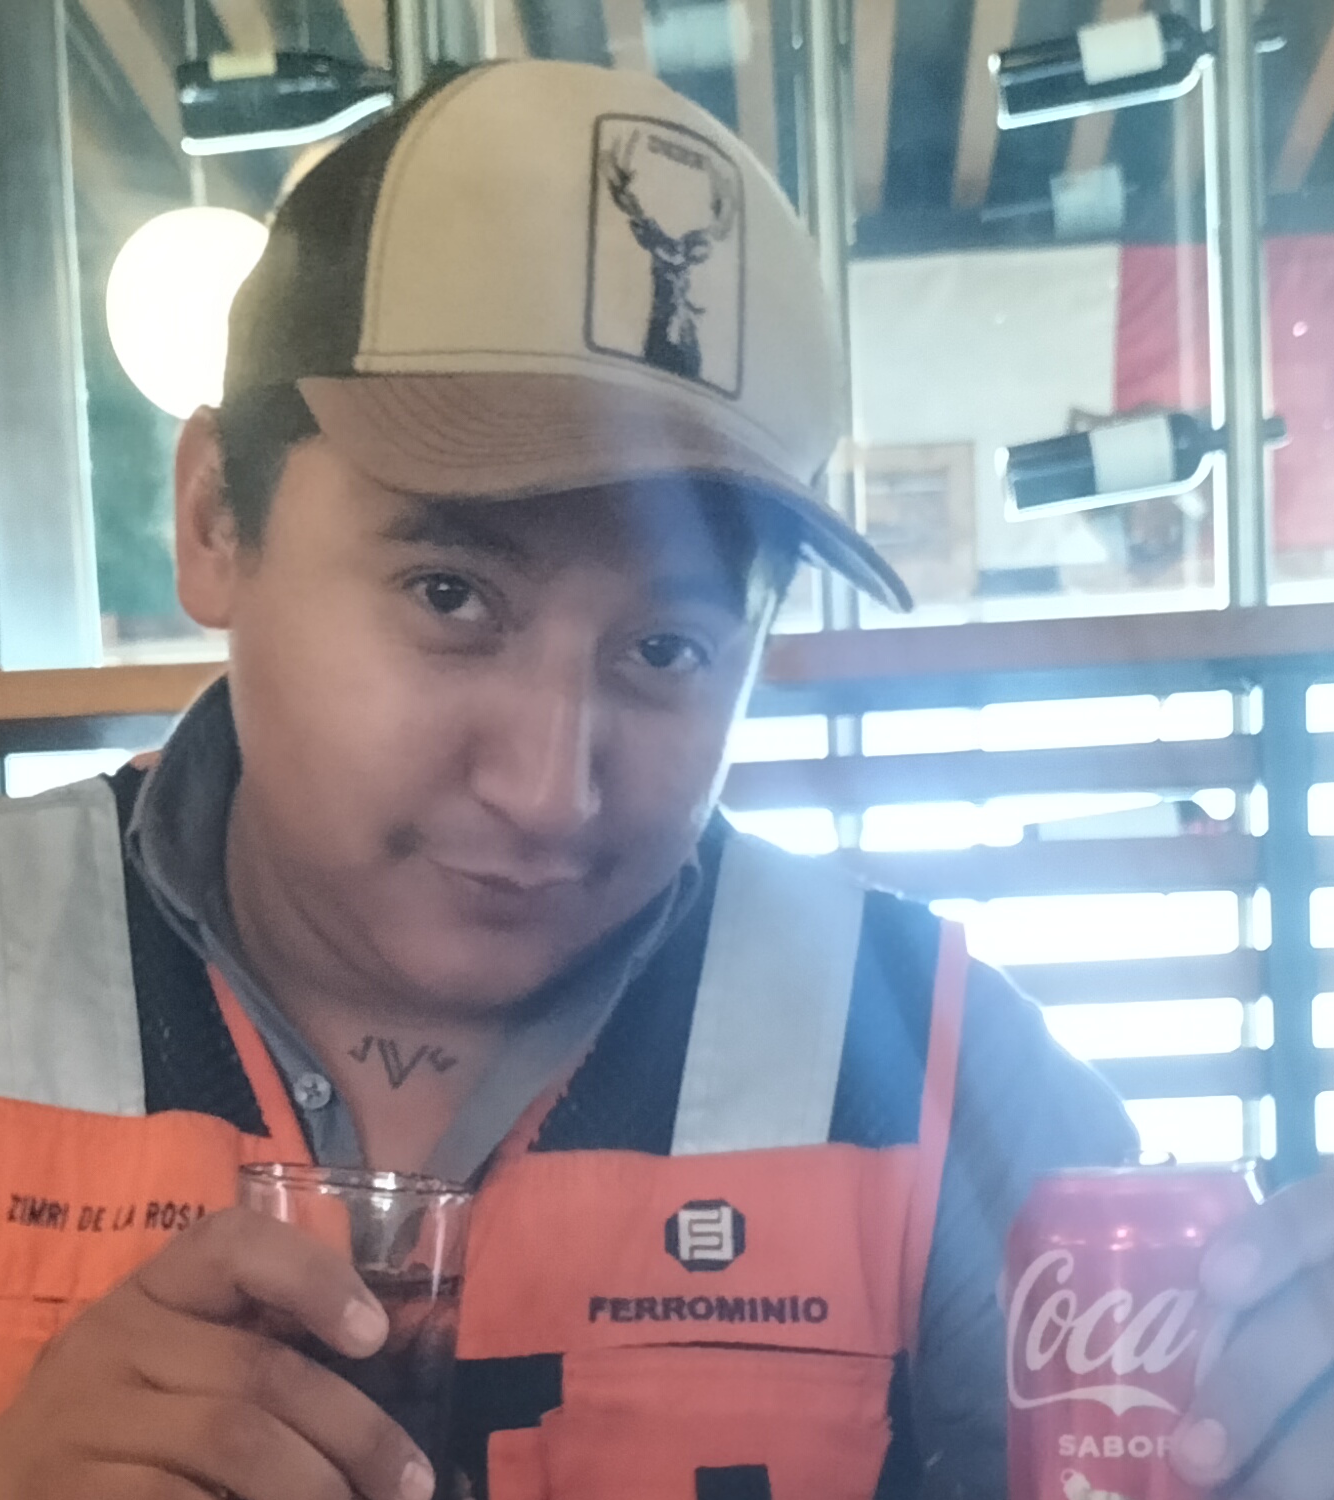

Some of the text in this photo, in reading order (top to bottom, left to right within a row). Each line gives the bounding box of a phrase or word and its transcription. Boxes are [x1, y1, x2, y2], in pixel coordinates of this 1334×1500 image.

[7, 1193, 70, 1232] ZIMRI
[77, 1204, 106, 1232] DE
[112, 1204, 137, 1232] LA
[588, 1295, 829, 1324] FERROMINIO
